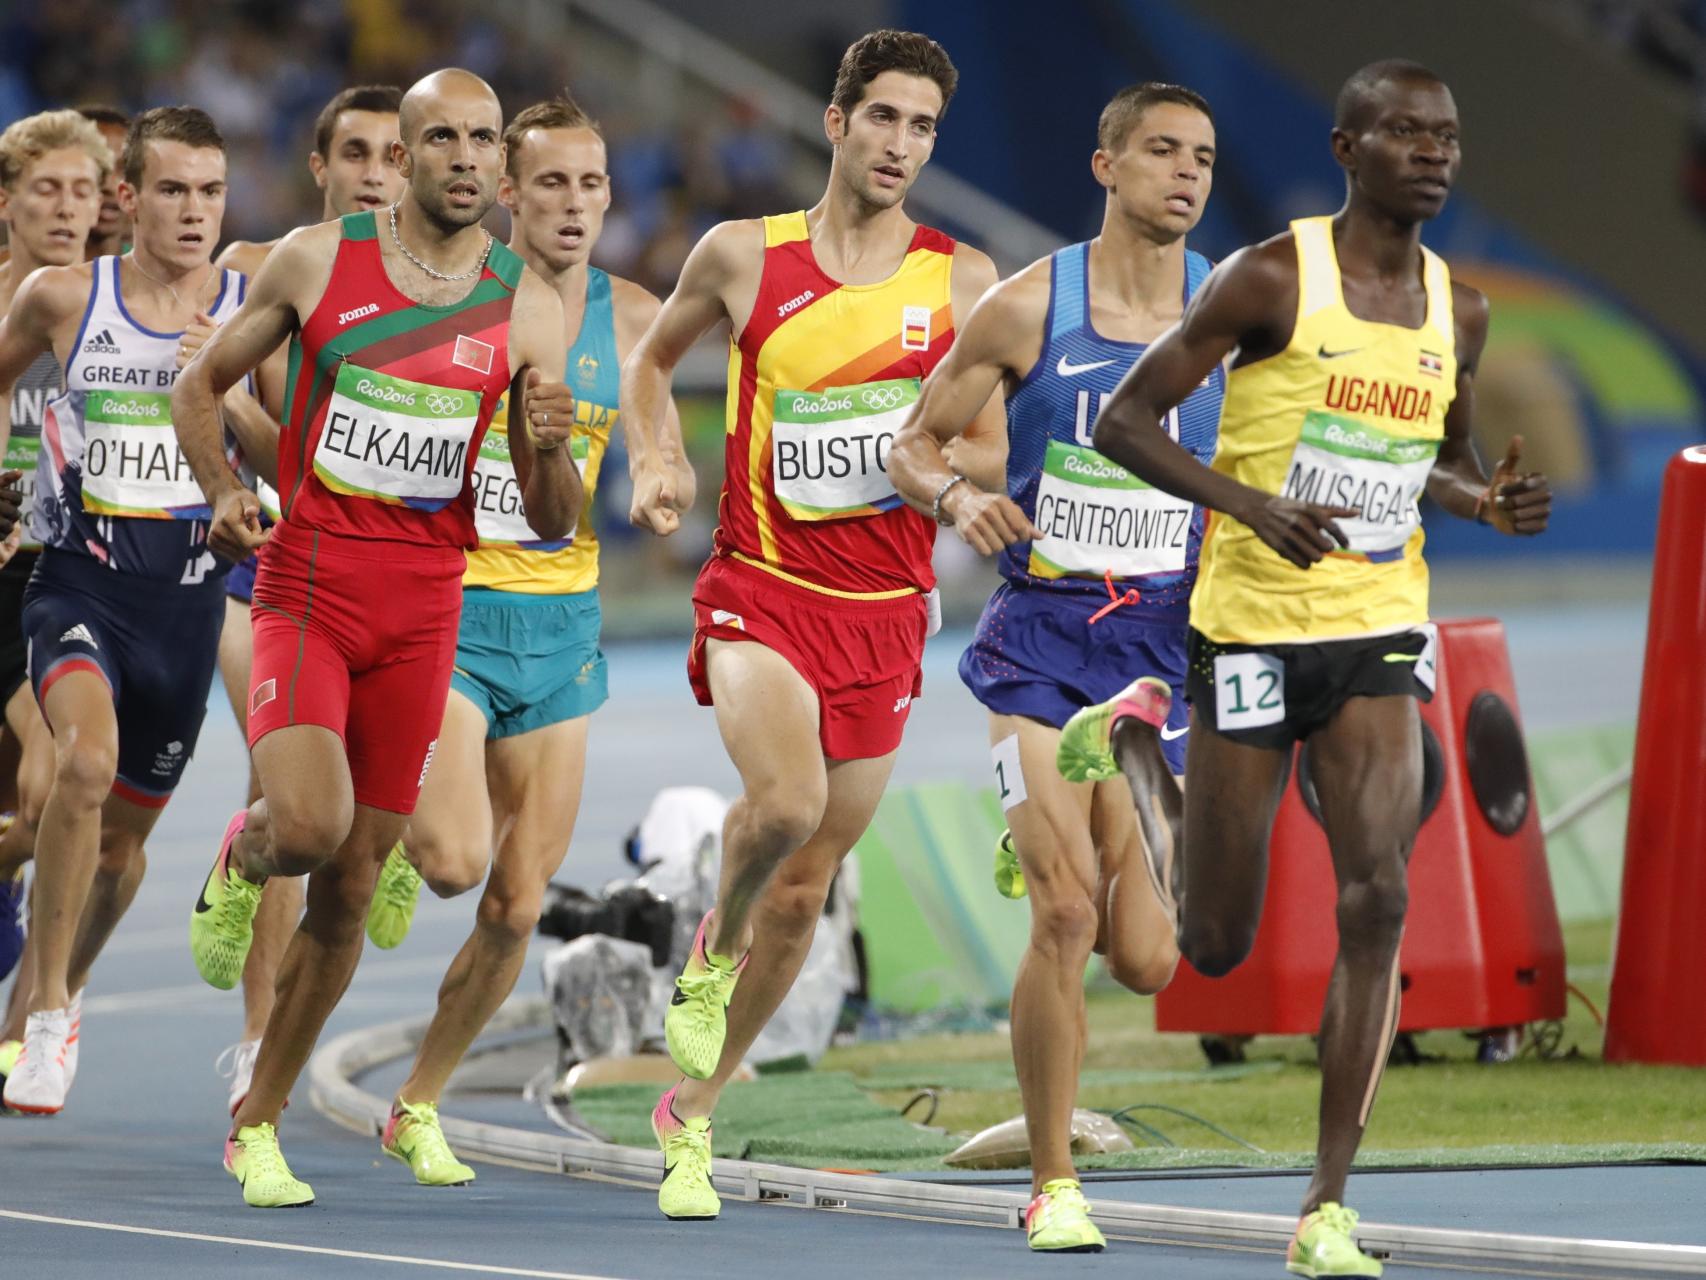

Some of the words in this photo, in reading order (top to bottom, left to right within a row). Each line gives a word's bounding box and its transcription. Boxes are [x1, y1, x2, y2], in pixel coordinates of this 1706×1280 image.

[83, 343, 121, 354] adidas
[82, 365, 150, 386] GREAT
[101, 397, 160, 417] Rio2016
[355, 379, 416, 406] Rio2016
[792, 396, 853, 414] Rio2016
[1324, 374, 1432, 424] UGANDA
[323, 411, 466, 480] ELKAAM
[1323, 423, 1390, 456] Rio2016
[1064, 455, 1128, 481] Rio2016
[1036, 493, 1189, 549] CENTROWITZ
[1224, 669, 1281, 714] 12
[995, 759, 1011, 801] 1
